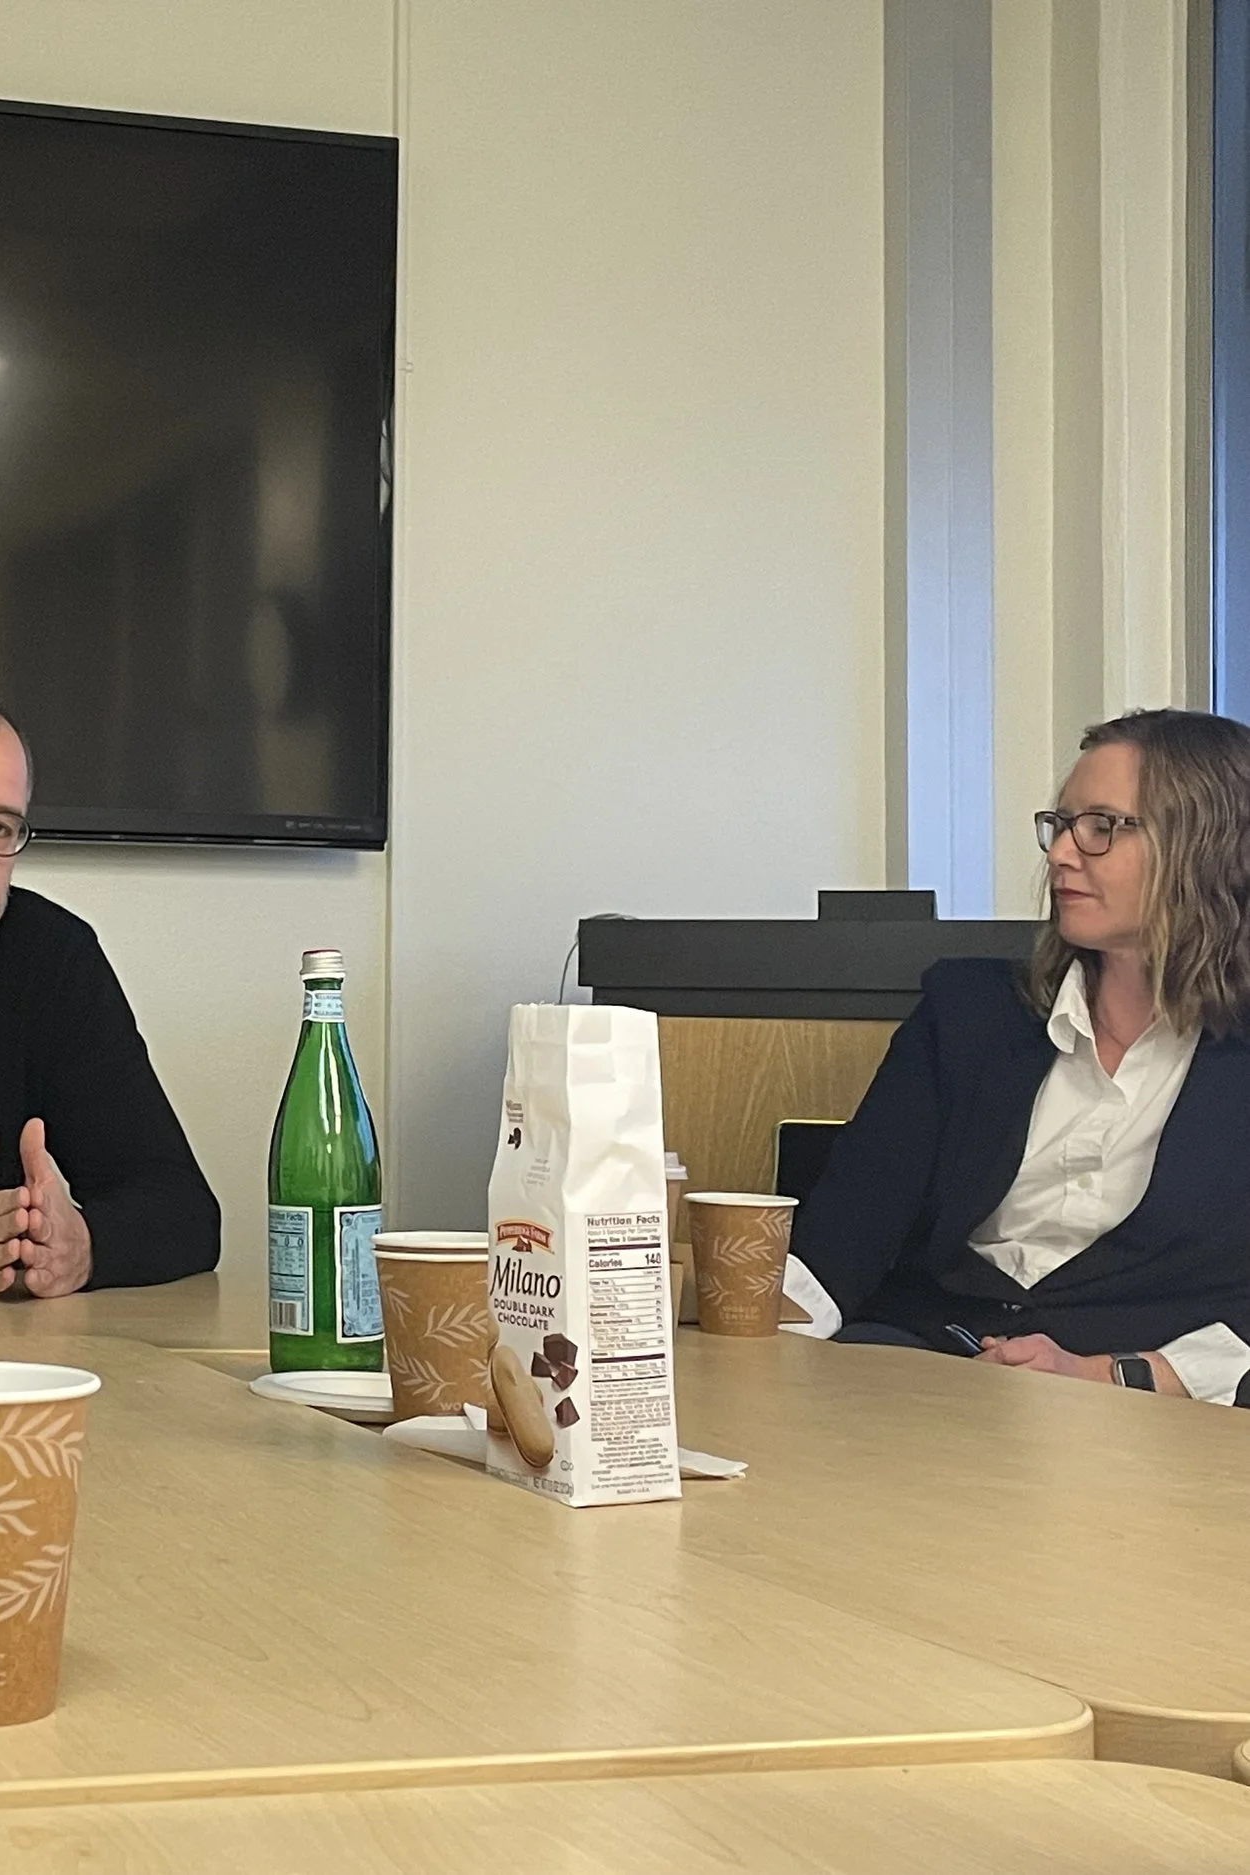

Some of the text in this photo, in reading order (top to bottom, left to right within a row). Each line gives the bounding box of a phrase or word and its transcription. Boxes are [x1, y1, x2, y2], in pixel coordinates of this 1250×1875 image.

[587, 1215, 660, 1227] Nutrition Facts
[589, 1252, 662, 1268] Calories 140
[489, 1255, 561, 1299] Milano
[494, 1298, 555, 1319] DOUBLE DARK
[497, 1311, 549, 1332] CHOCOLATE
